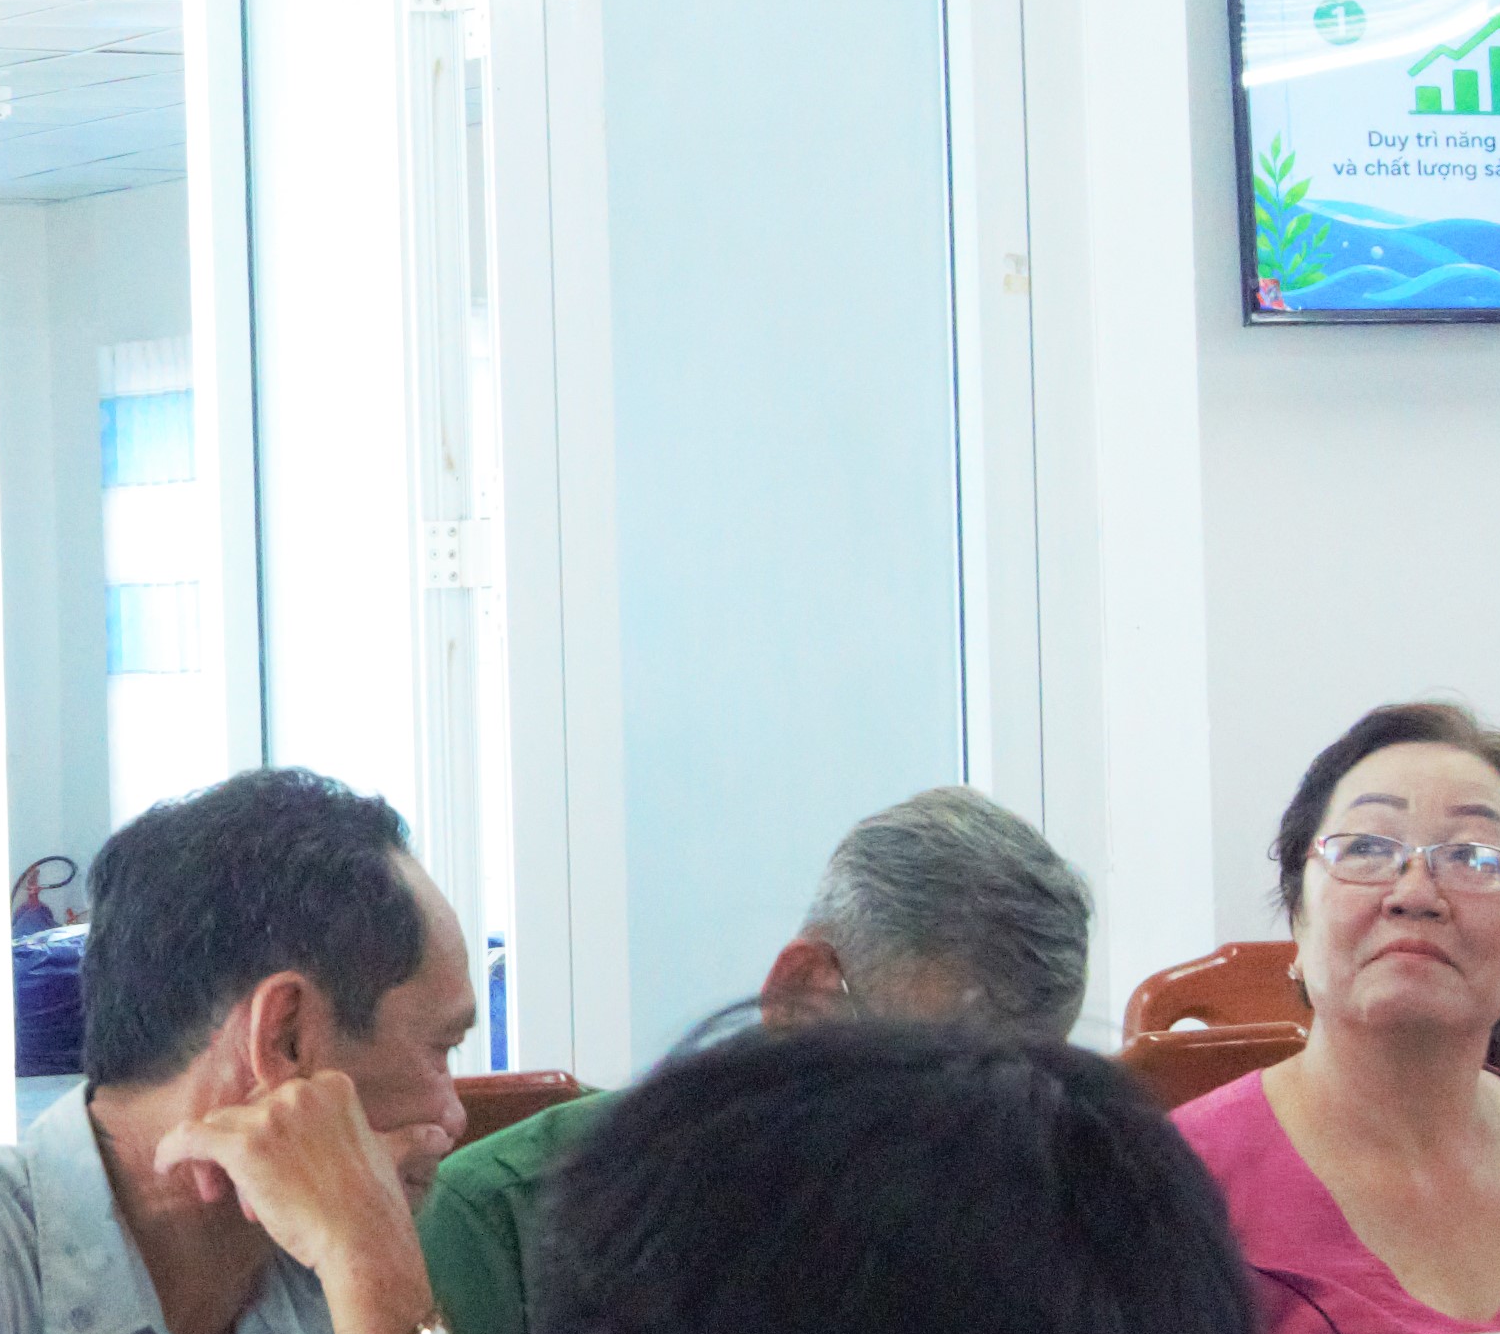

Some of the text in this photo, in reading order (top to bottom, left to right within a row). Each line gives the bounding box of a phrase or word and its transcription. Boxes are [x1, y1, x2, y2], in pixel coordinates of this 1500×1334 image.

[1367, 130, 1410, 152] Duy
[1415, 130, 1439, 149] trì
[1445, 131, 1498, 153] năng
[1332, 158, 1359, 177] và
[1363, 155, 1411, 177] chất
[1416, 158, 1479, 182] lượng
